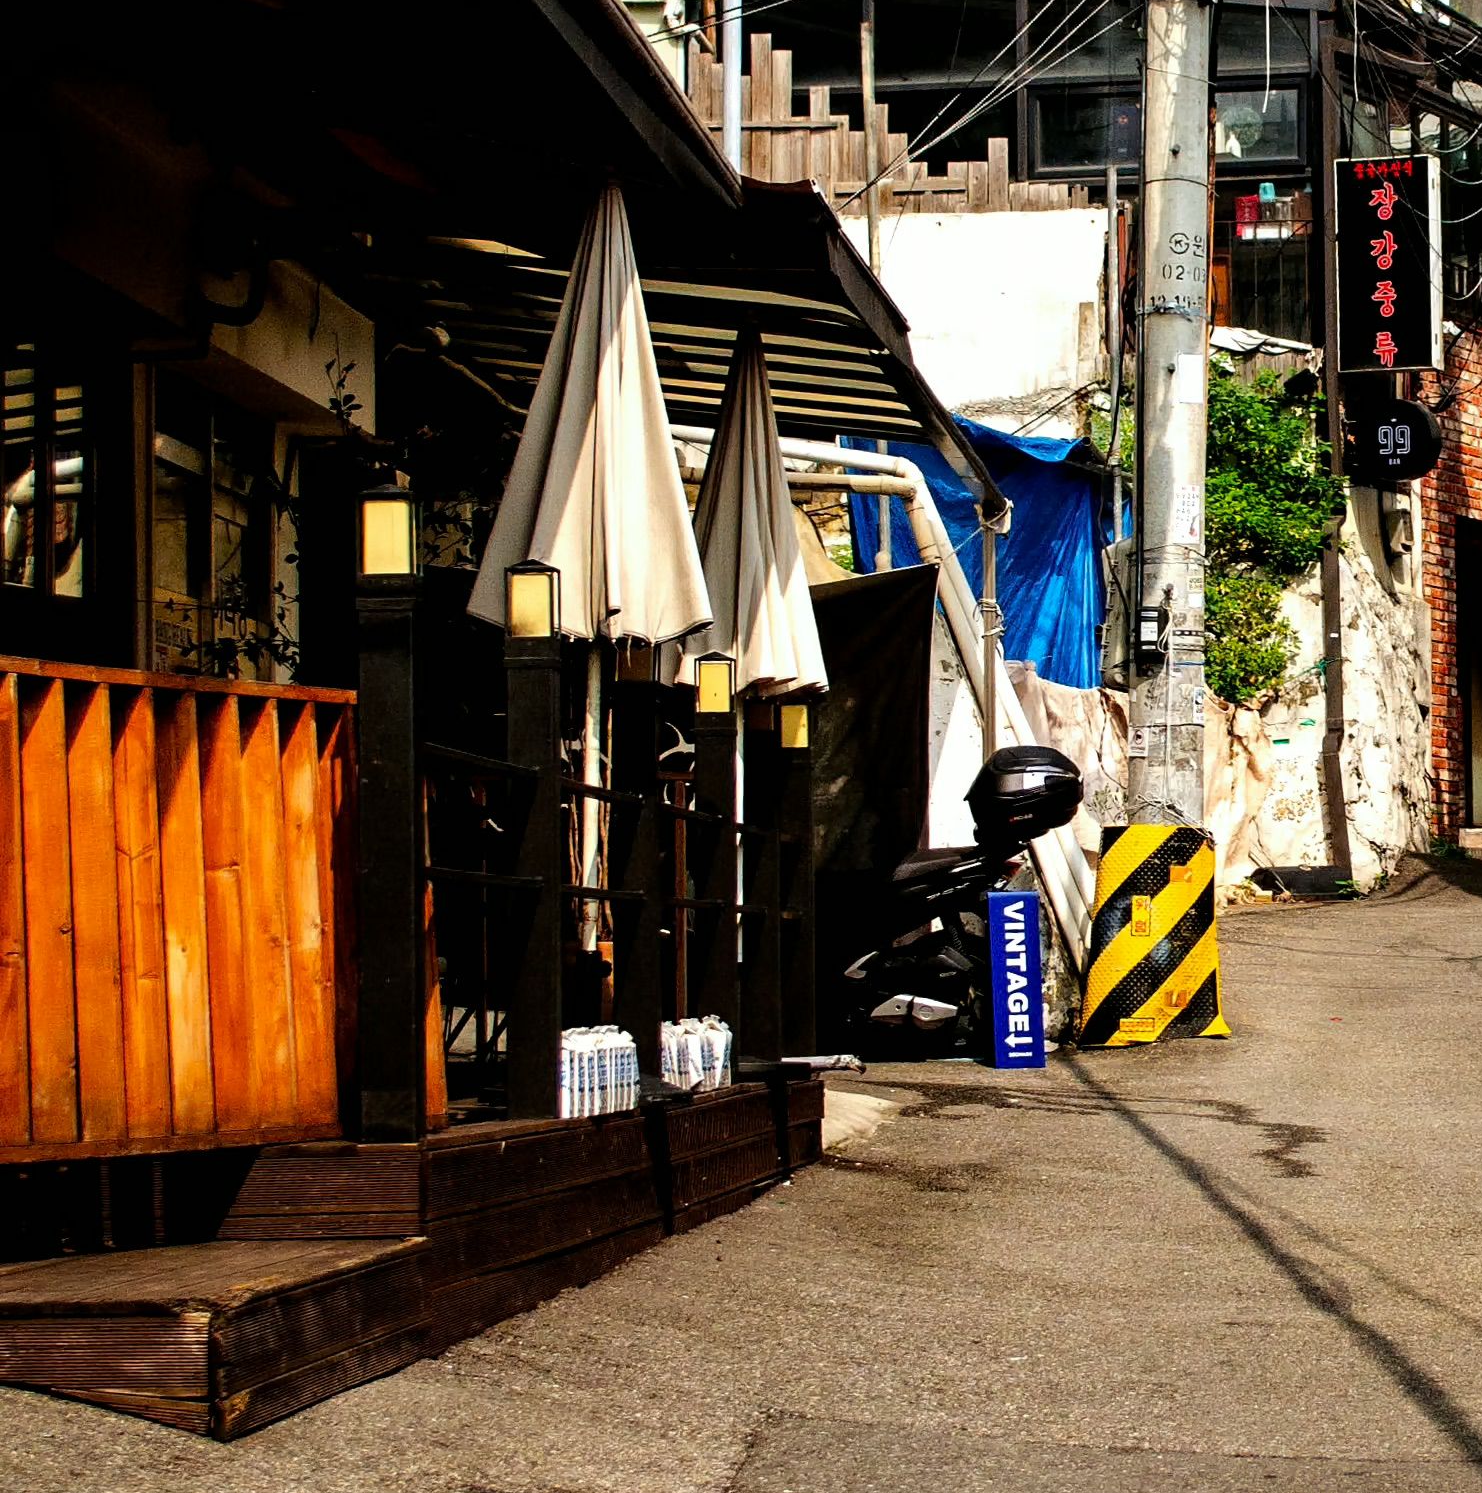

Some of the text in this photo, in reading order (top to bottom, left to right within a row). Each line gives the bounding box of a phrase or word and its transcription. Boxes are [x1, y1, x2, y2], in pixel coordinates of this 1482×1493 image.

[1368, 181, 1398, 368] 장강중류
[1378, 424, 1412, 455] 99
[1003, 900, 1031, 1033] VINTAGE
